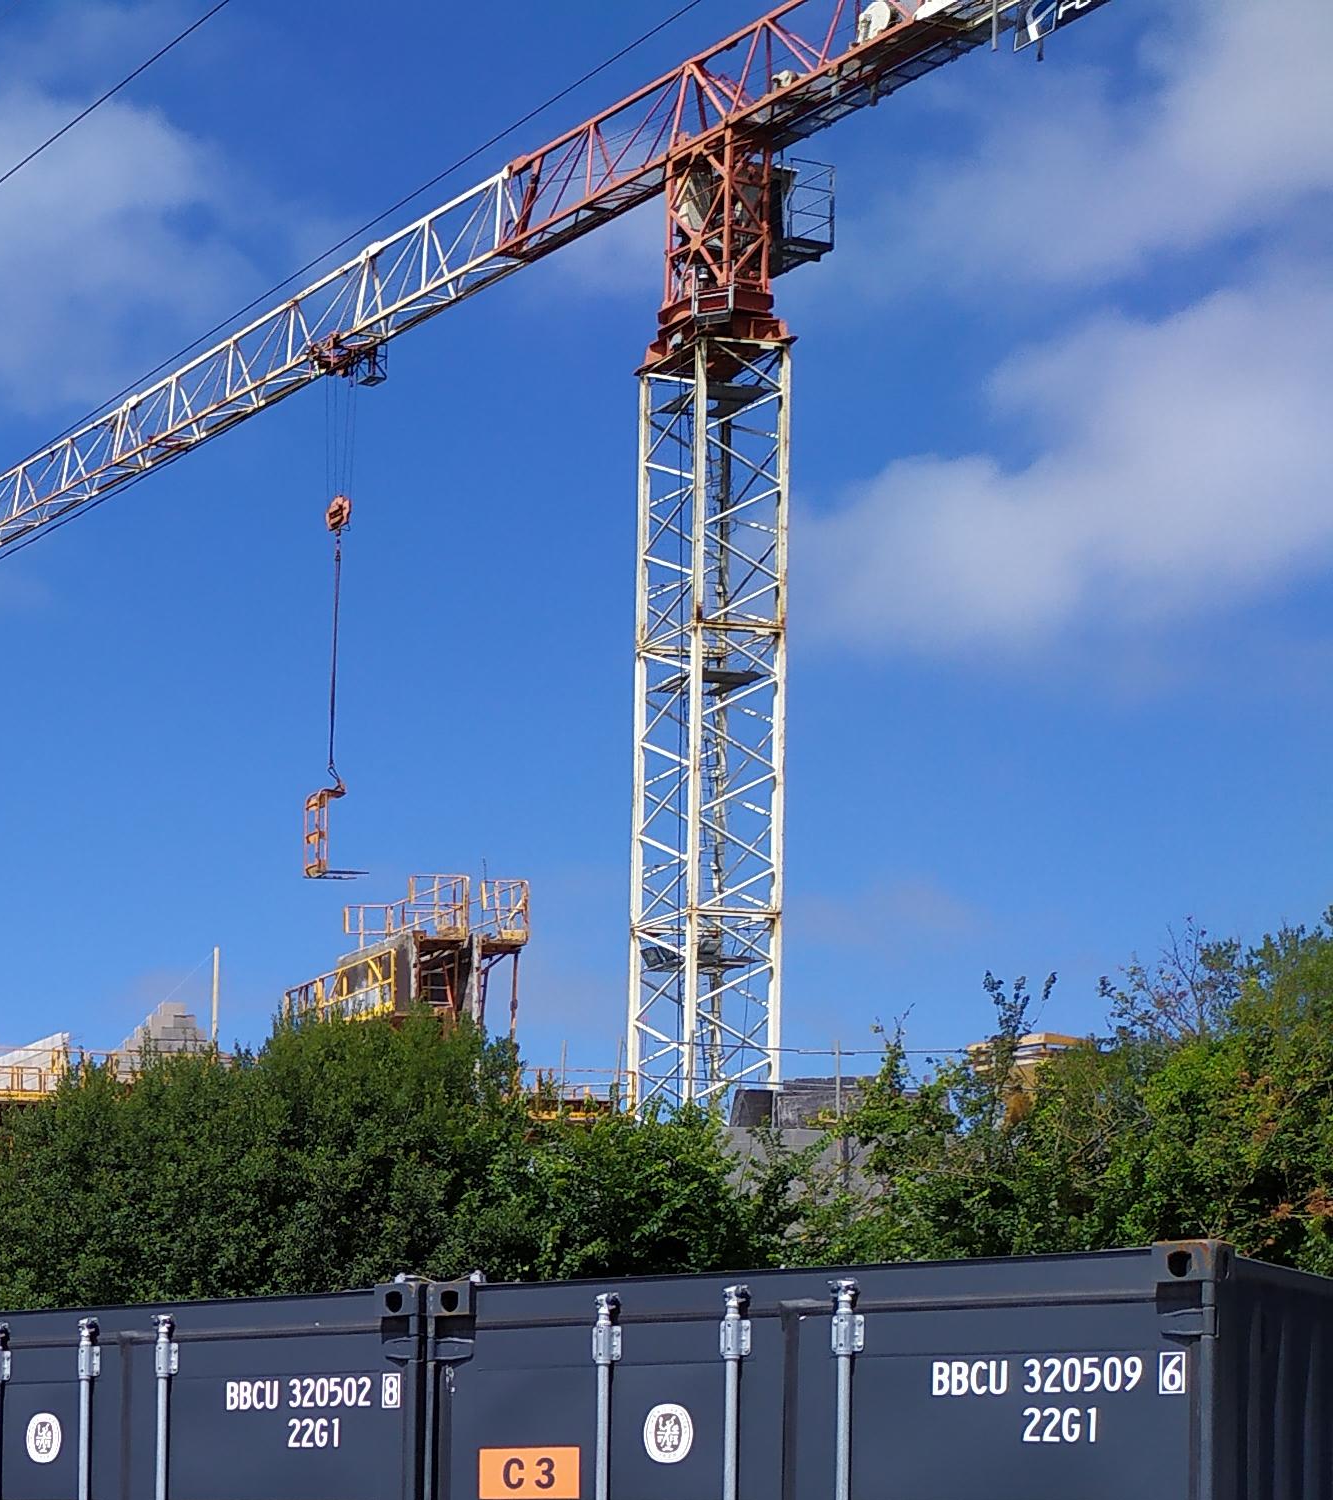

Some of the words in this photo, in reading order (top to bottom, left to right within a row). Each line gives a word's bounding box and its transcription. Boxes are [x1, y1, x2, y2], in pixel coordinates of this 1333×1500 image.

[932, 1360, 1008, 1396] BBCU
[1023, 1356, 1143, 1393] 320509
[1162, 1355, 1182, 1391] 6
[226, 1380, 279, 1411] BBCU
[288, 1376, 372, 1408] 320502
[384, 1376, 399, 1405] 8
[287, 1417, 340, 1448] 22G1
[1023, 1407, 1097, 1443] 22G1
